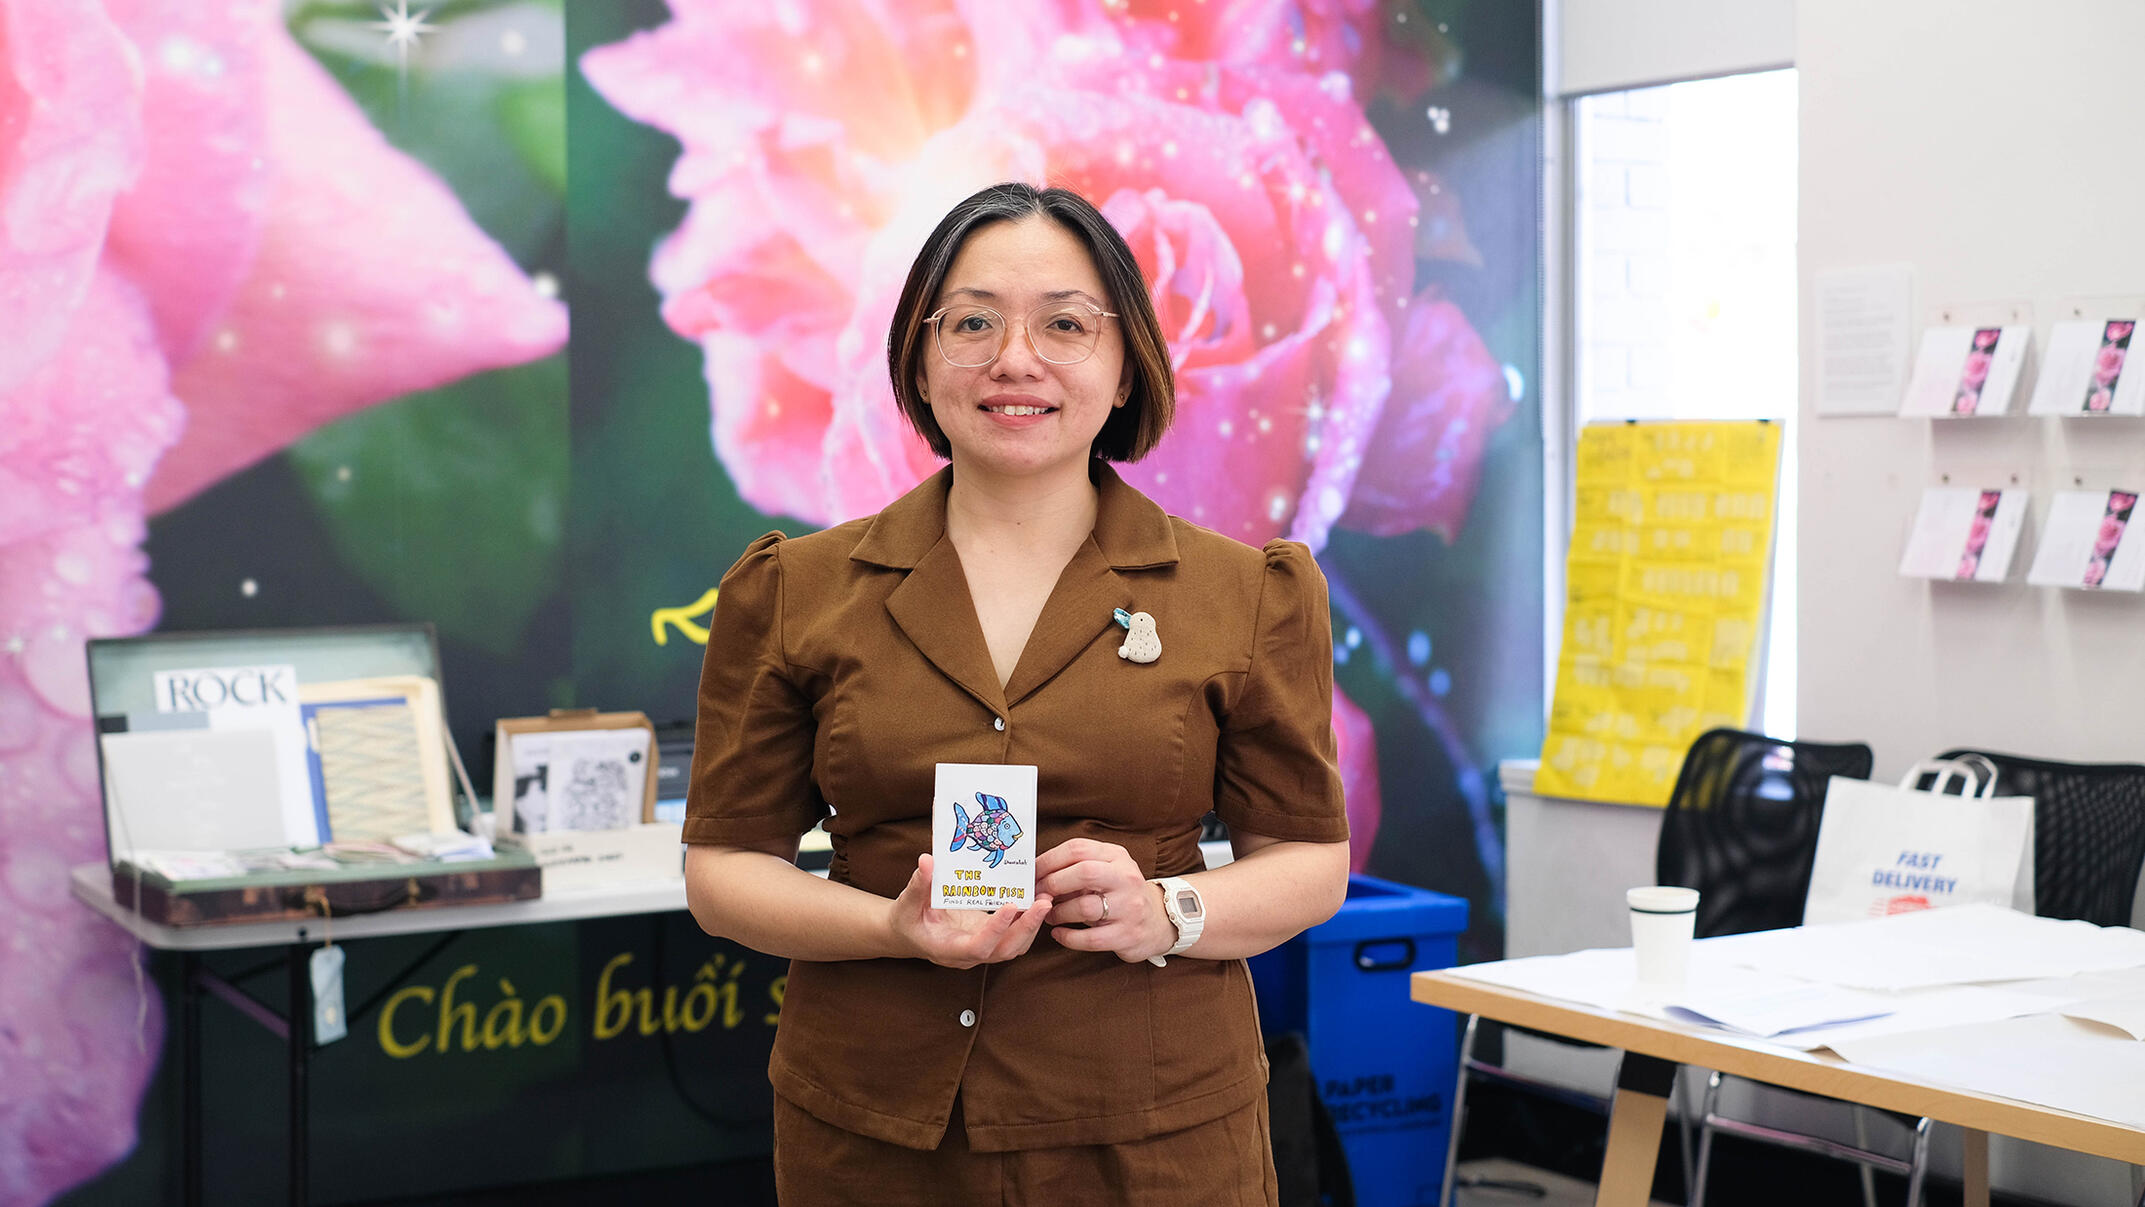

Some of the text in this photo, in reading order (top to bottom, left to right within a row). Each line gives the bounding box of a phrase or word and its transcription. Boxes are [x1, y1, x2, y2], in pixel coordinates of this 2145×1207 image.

[168, 668, 288, 711] ROCK
[1896, 850, 1943, 869] FAST
[954, 869, 982, 881] THE
[1872, 869, 1958, 893] DELIVERY
[942, 885, 1025, 899] RAINBOW FISH
[378, 963, 567, 1058] Chào
[1325, 1075, 1394, 1097] PAPER
